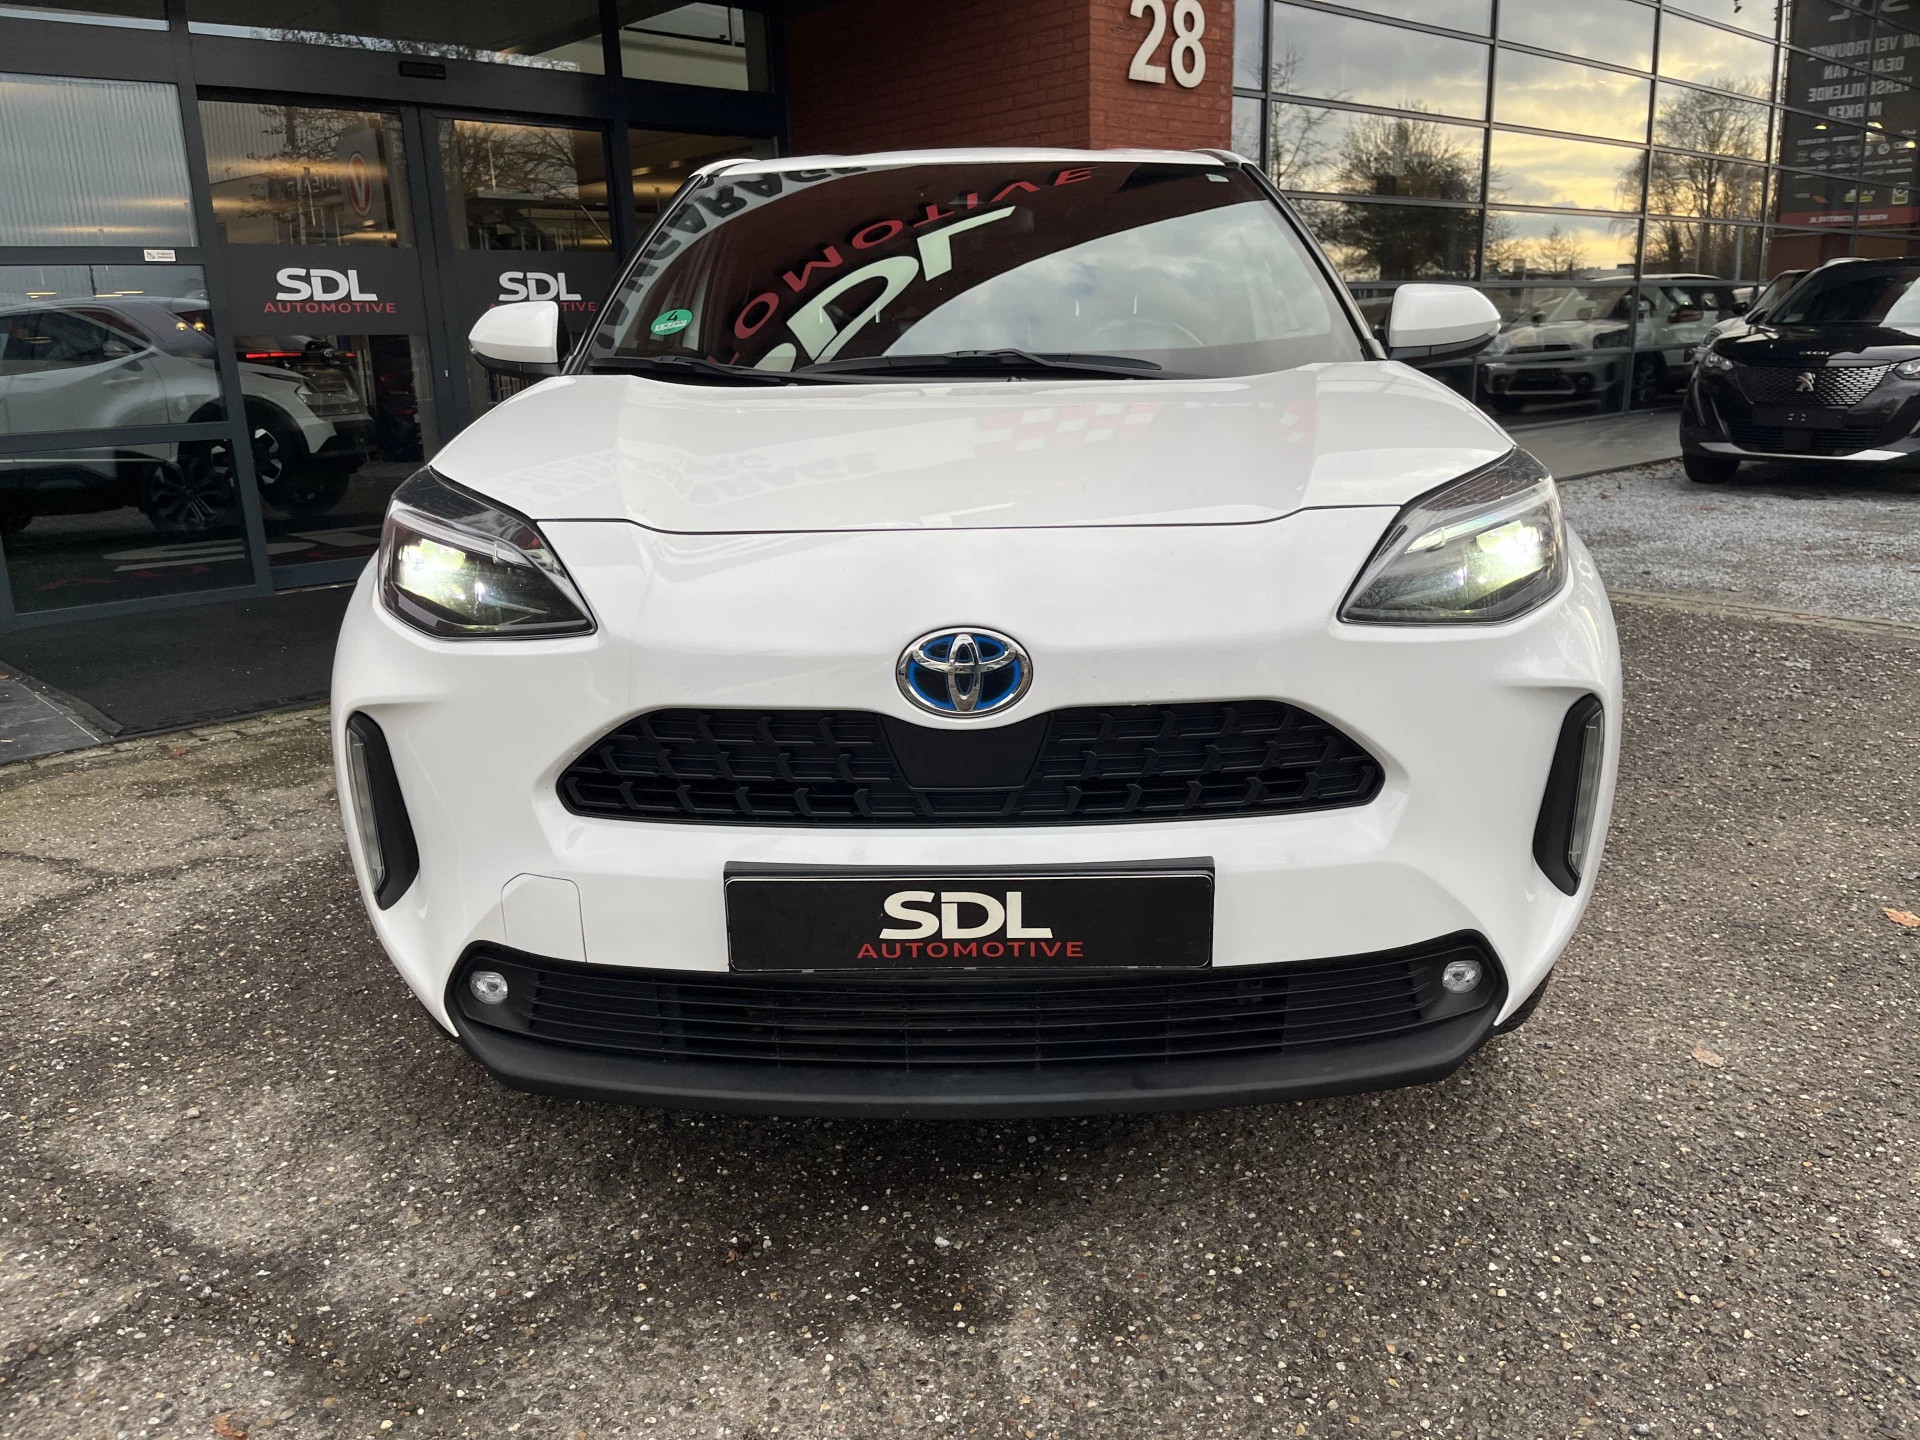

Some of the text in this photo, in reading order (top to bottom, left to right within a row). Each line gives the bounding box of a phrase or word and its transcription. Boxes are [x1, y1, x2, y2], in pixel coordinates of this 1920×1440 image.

[1128, 0, 1206, 88] 28
[276, 267, 378, 301] SDL
[498, 271, 582, 301] SDL
[264, 301, 396, 314] AUTOMOTIVE
[666, 310, 679, 321] 4
[879, 890, 1053, 940] SDL
[856, 940, 1084, 959] AUTOMOTIVE
